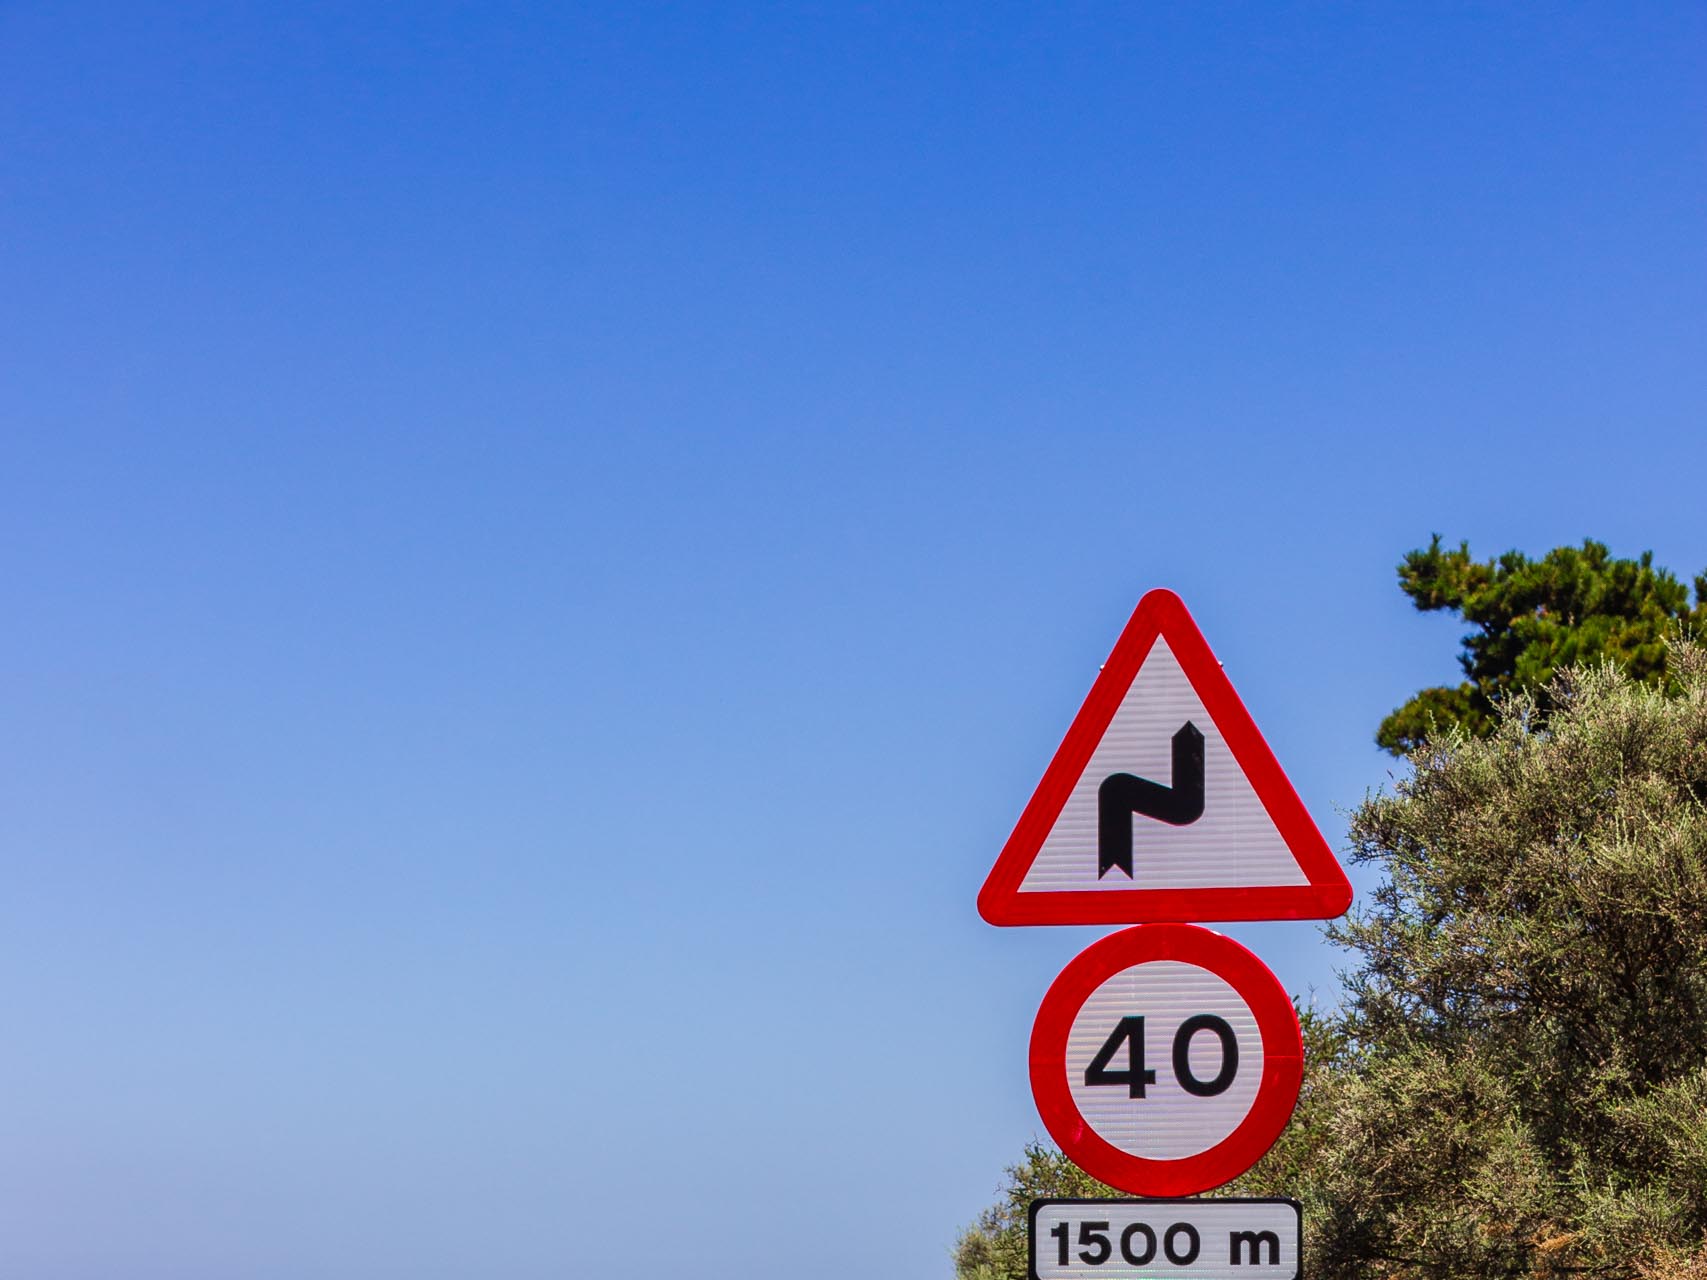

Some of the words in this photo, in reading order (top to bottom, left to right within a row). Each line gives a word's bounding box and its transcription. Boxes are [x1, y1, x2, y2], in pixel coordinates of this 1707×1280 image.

[1084, 1014, 1239, 1099] 40
[1050, 1221, 1201, 1267] 1500
[1229, 1230, 1281, 1266] m
